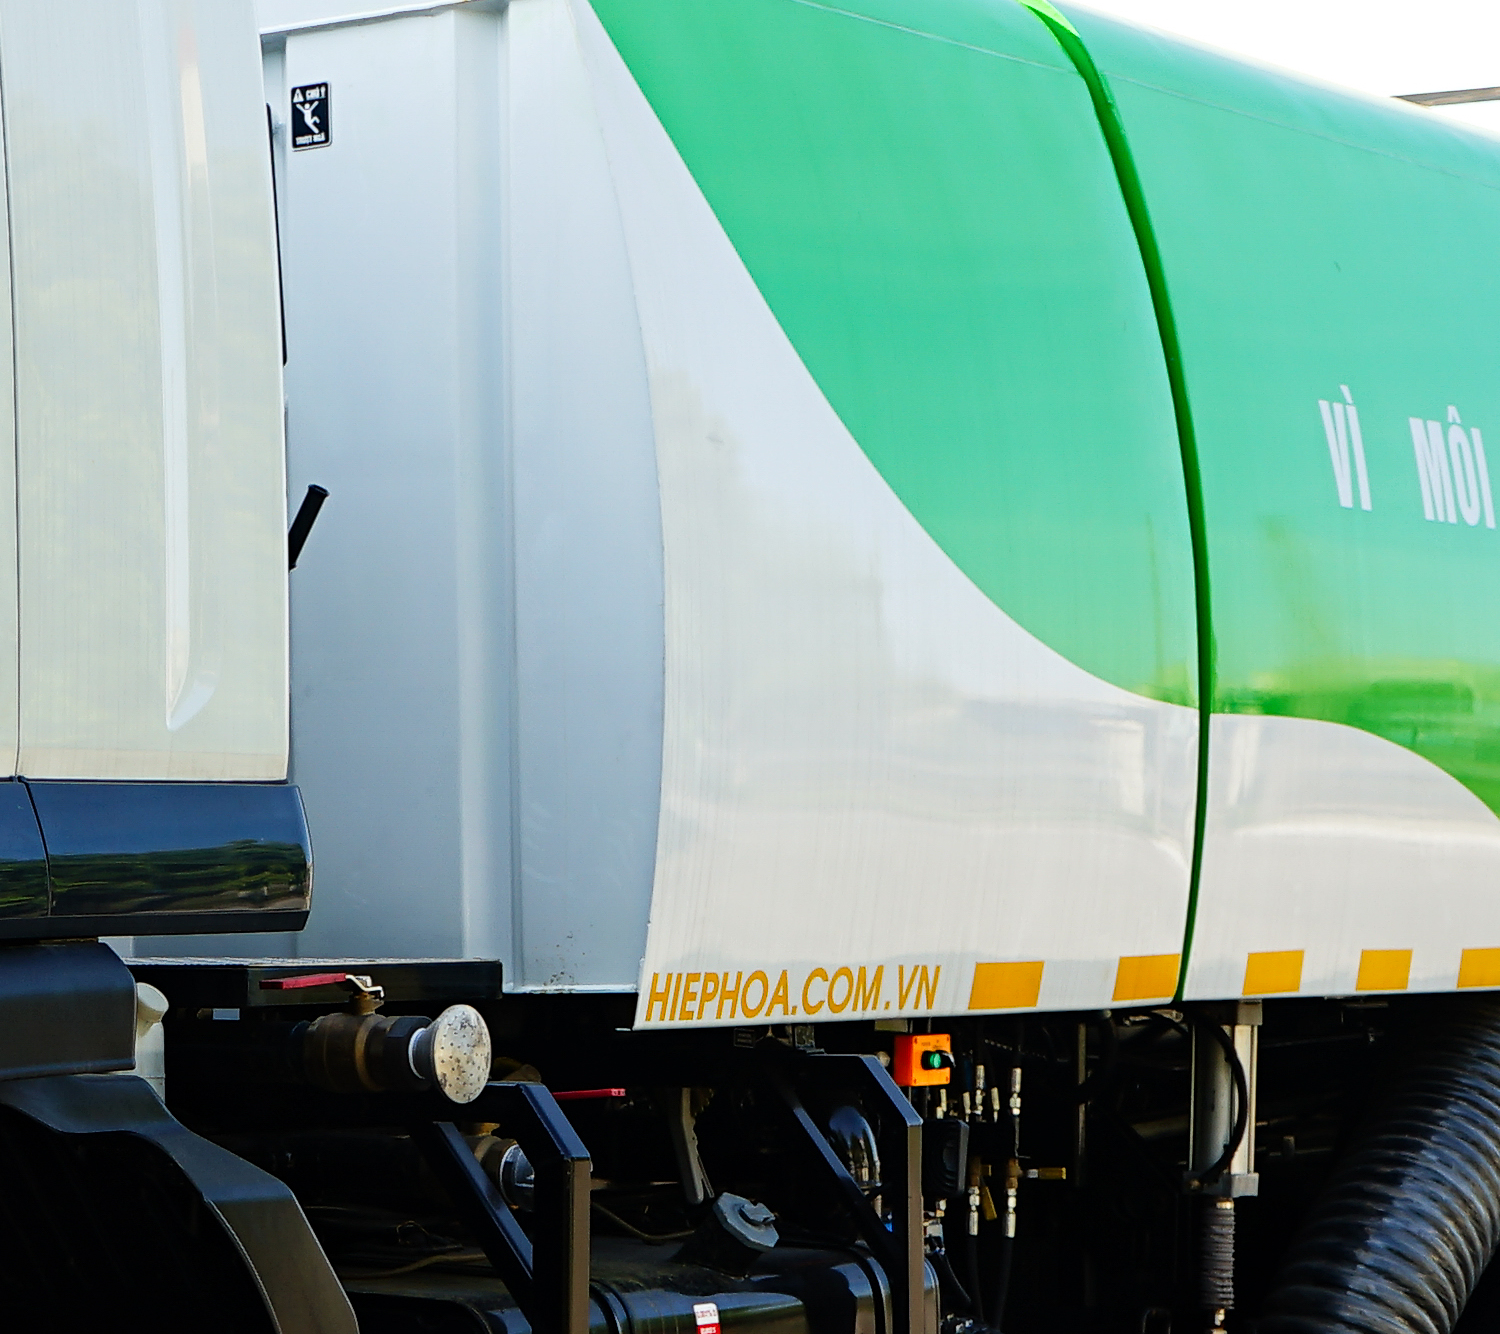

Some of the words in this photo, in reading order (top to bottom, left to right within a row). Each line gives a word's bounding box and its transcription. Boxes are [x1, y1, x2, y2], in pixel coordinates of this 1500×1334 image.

[1318, 384, 1371, 511] VÌ
[1409, 405, 1496, 529] MÔI
[645, 965, 941, 1022] HIEPHOA.COM.VN
